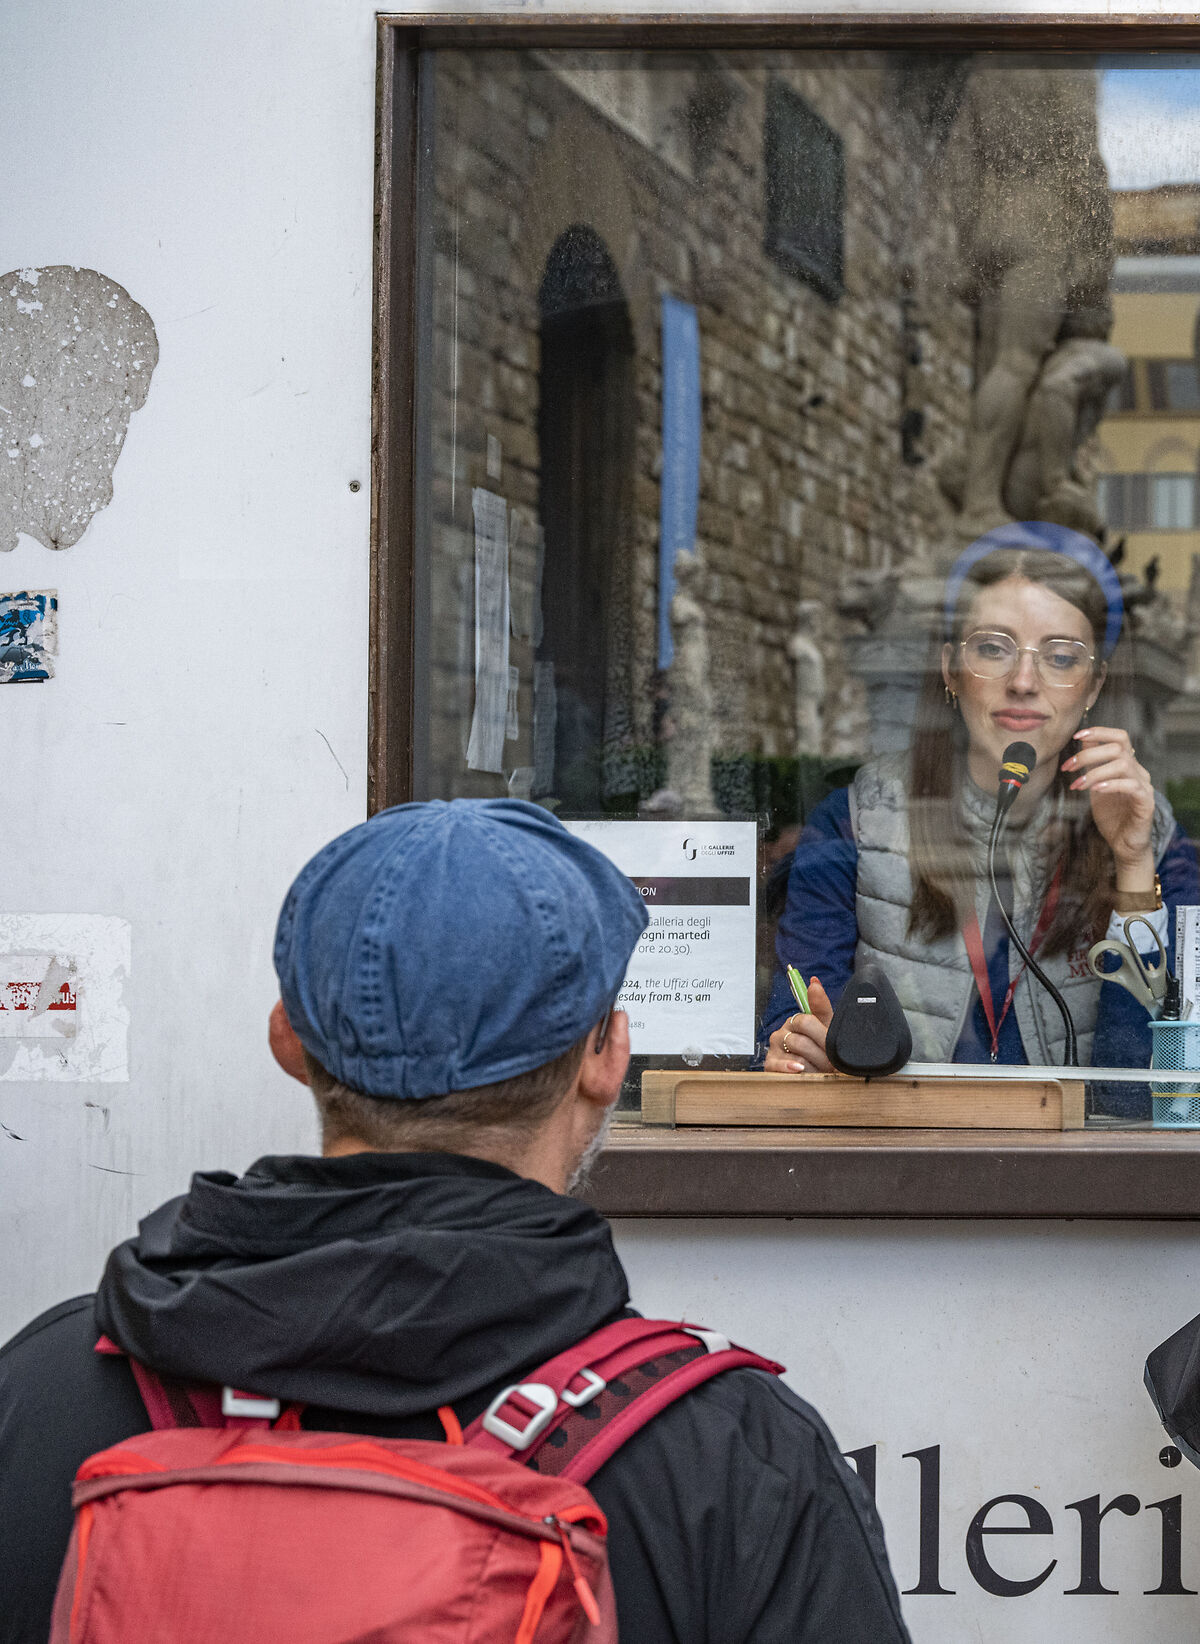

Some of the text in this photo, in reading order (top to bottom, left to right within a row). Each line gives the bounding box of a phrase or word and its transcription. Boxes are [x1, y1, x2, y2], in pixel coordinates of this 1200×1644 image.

[648, 916, 711, 928] Galleria degli
[641, 930, 710, 941] ogni martedì
[639, 945, 655, 953] ore
[658, 943, 692, 956] 20.30).
[620, 978, 724, 990] 024, the Uffizi Gallery
[616, 991, 711, 1003] esday from 8.15 am
